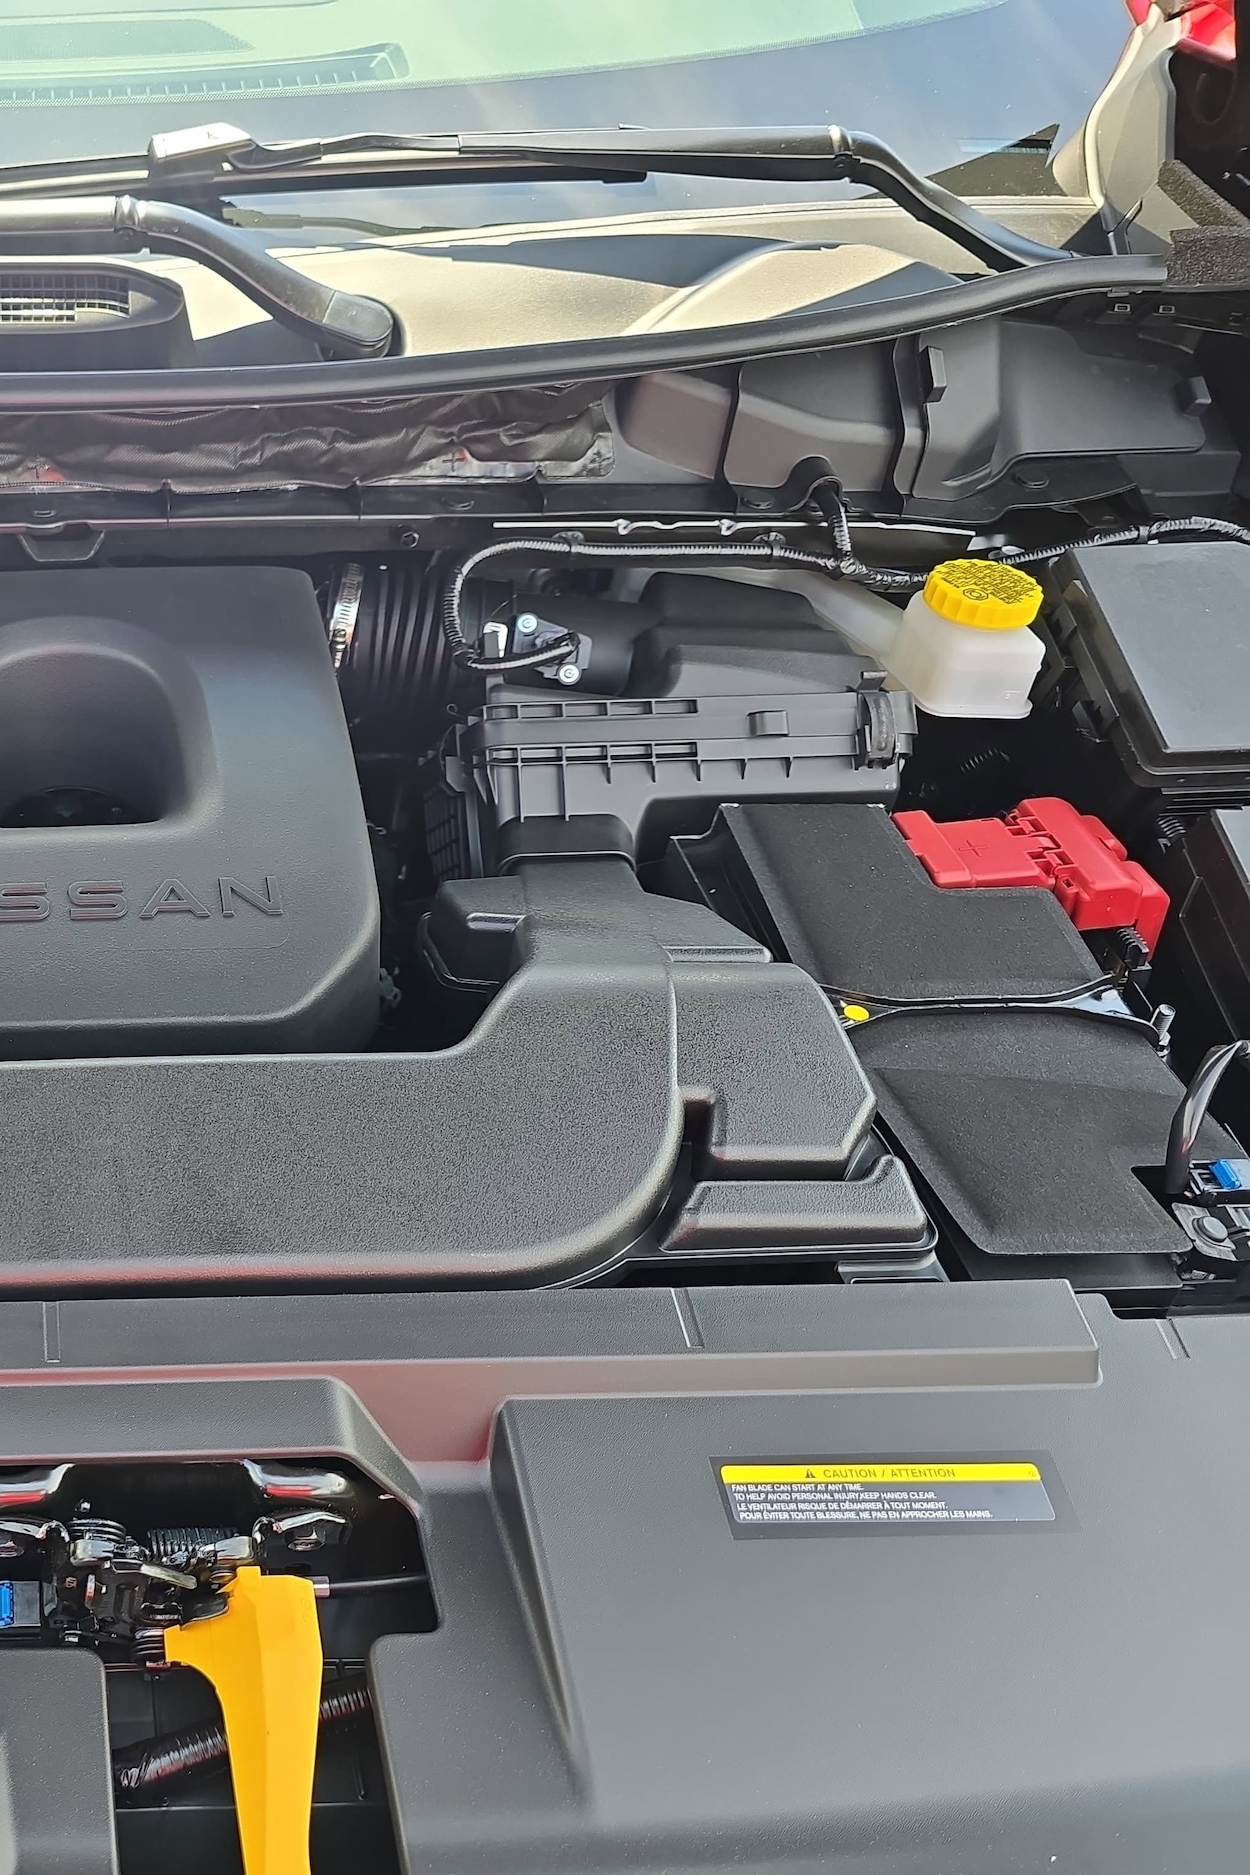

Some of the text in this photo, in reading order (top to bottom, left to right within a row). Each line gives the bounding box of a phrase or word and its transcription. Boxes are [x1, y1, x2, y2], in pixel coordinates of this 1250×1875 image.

[823, 1468, 877, 1478] CAUTION
[890, 1468, 956, 1478] ATTENTION
[731, 1483, 747, 1492] FAN
[748, 1483, 772, 1492] BLADE
[773, 1483, 791, 1492] CAN
[792, 1483, 816, 1492] START
[817, 1483, 827, 1491] AT
[827, 1483, 843, 1491] ANY
[734, 1493, 745, 1501] TO
[746, 1492, 766, 1500] HELP
[768, 1492, 791, 1500] AVOID
[792, 1492, 833, 1500] PERSONAL
[881, 1491, 908, 1499] HANDS
[737, 1503, 747, 1511] LE
[747, 1502, 796, 1511] VENTILATEUR
[798, 1502, 827, 1511] RISQUE
[828, 1502, 839, 1510] DE
[840, 1500, 882, 1510] DÉMARRER
[883, 1500, 891, 1510] À
[891, 1501, 911, 1510] TOUT
[739, 1512, 763, 1520] POUR
[763, 1510, 790, 1520] ÉVITER
[790, 1512, 815, 1520] TOUTE
[860, 1511, 871, 1519] NE
[871, 1511, 888, 1519] PAS
[888, 1511, 899, 1519] EN
[901, 1510, 949, 1519] APPROCHER
[949, 1510, 965, 1518] LES
